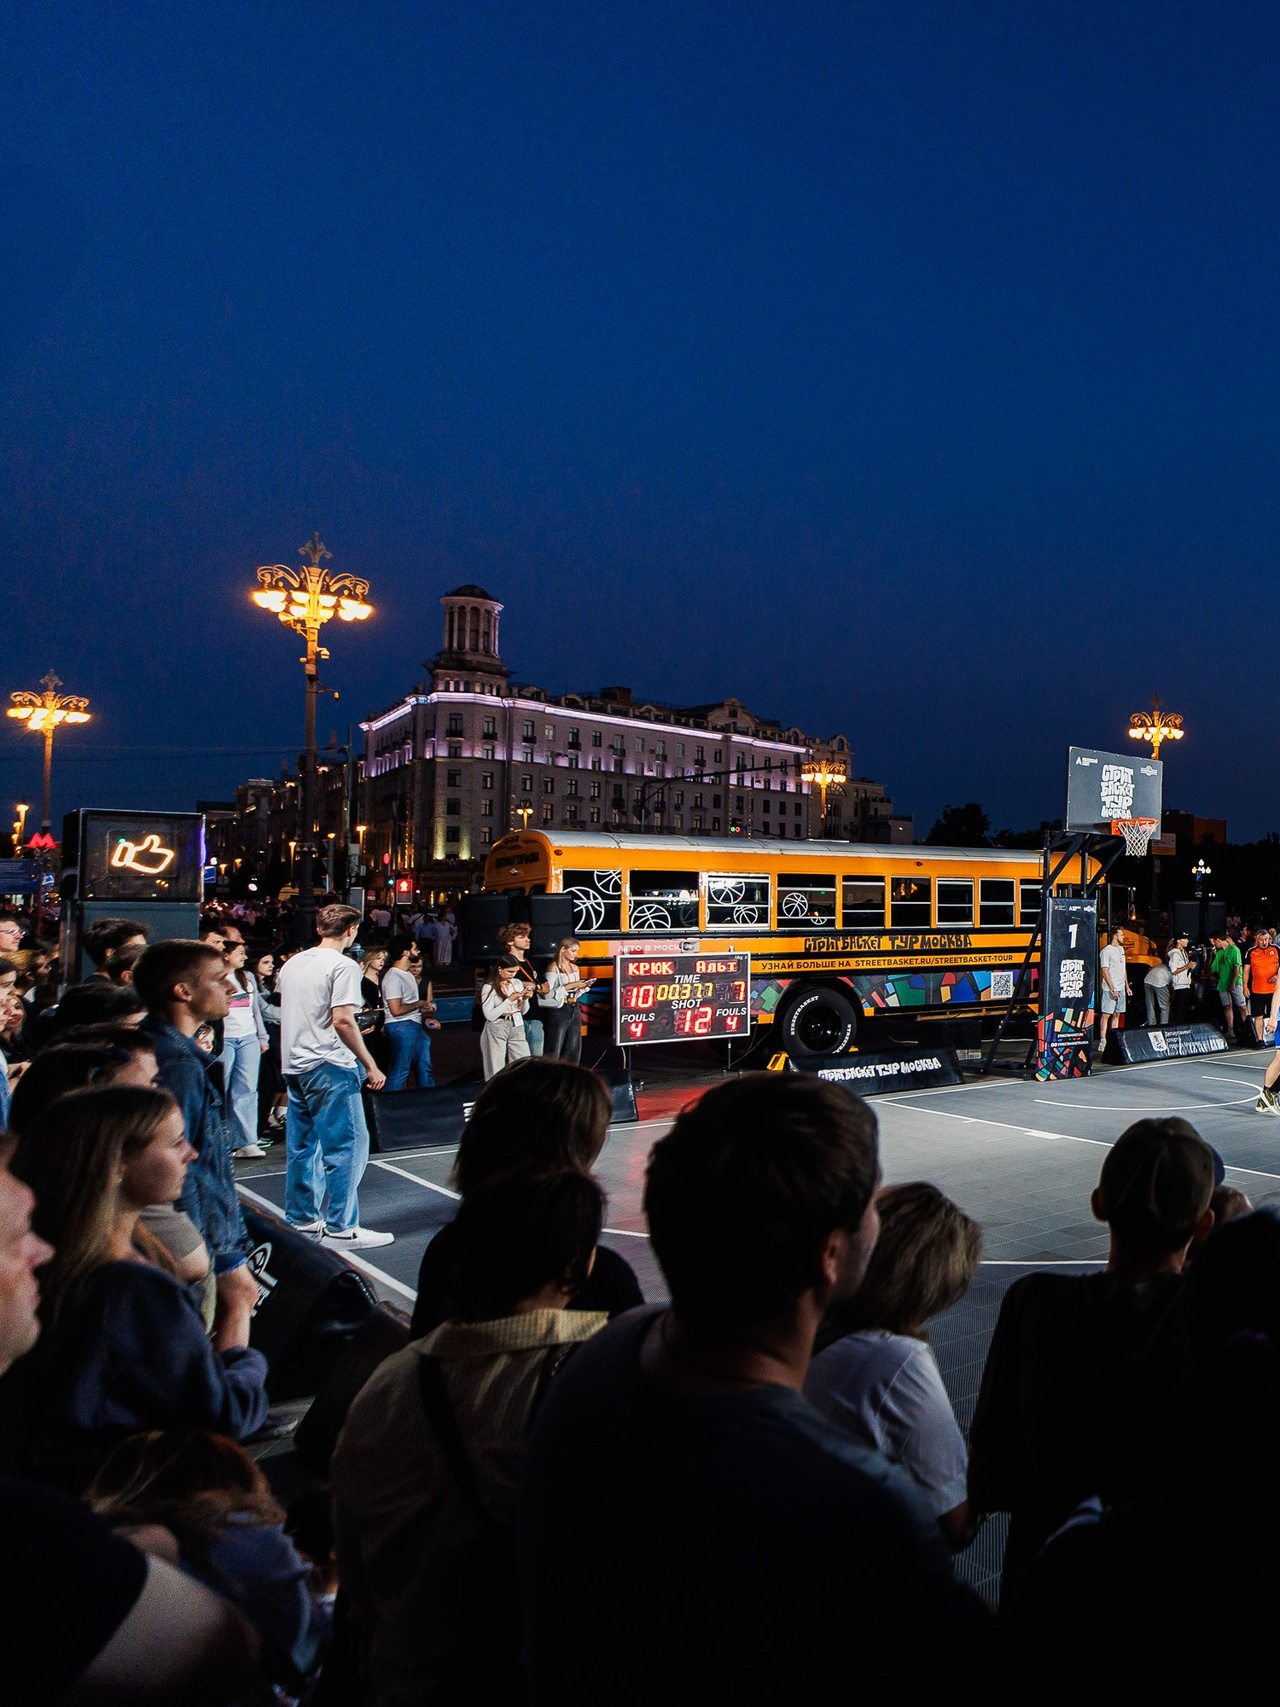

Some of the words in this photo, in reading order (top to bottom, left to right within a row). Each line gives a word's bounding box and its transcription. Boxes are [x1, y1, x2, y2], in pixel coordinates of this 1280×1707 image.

[1101, 764, 1134, 784] СТРИТ
[1100, 781, 1135, 798] БАСКЕТ
[1101, 795, 1132, 810] ТУР
[1101, 807, 1132, 820] МОСКВА
[889, 935, 919, 950] ТУР
[920, 934, 973, 950] МОСКВА
[1068, 923, 1079, 949] 1
[654, 944, 681, 952] МОСК
[628, 961, 674, 976] КРЮК
[761, 960, 794, 970] УЗНАЙ
[796, 960, 836, 969] БОЛЬШЕ
[838, 960, 851, 968] НА
[855, 955, 1013, 967] STREETBASKET.RU/STREETBASKET-TOUR
[674, 974, 701, 984] TIME
[1060, 981, 1084, 991] ТУР
[630, 985, 655, 1008] 10
[734, 981, 746, 1001] 7
[671, 998, 703, 1010] SHOT
[621, 1012, 656, 1023] FOULS
[716, 1007, 747, 1017] FOULS
[790, 995, 819, 1036] STREETBASKET
[683, 1007, 713, 1034] 12
[726, 1016, 739, 1030] 4
[630, 1022, 643, 1038] 4
[832, 1023, 852, 1054] STREETBA
[875, 1062, 900, 1077] ТУР
[900, 1057, 942, 1074] МОСКВА
